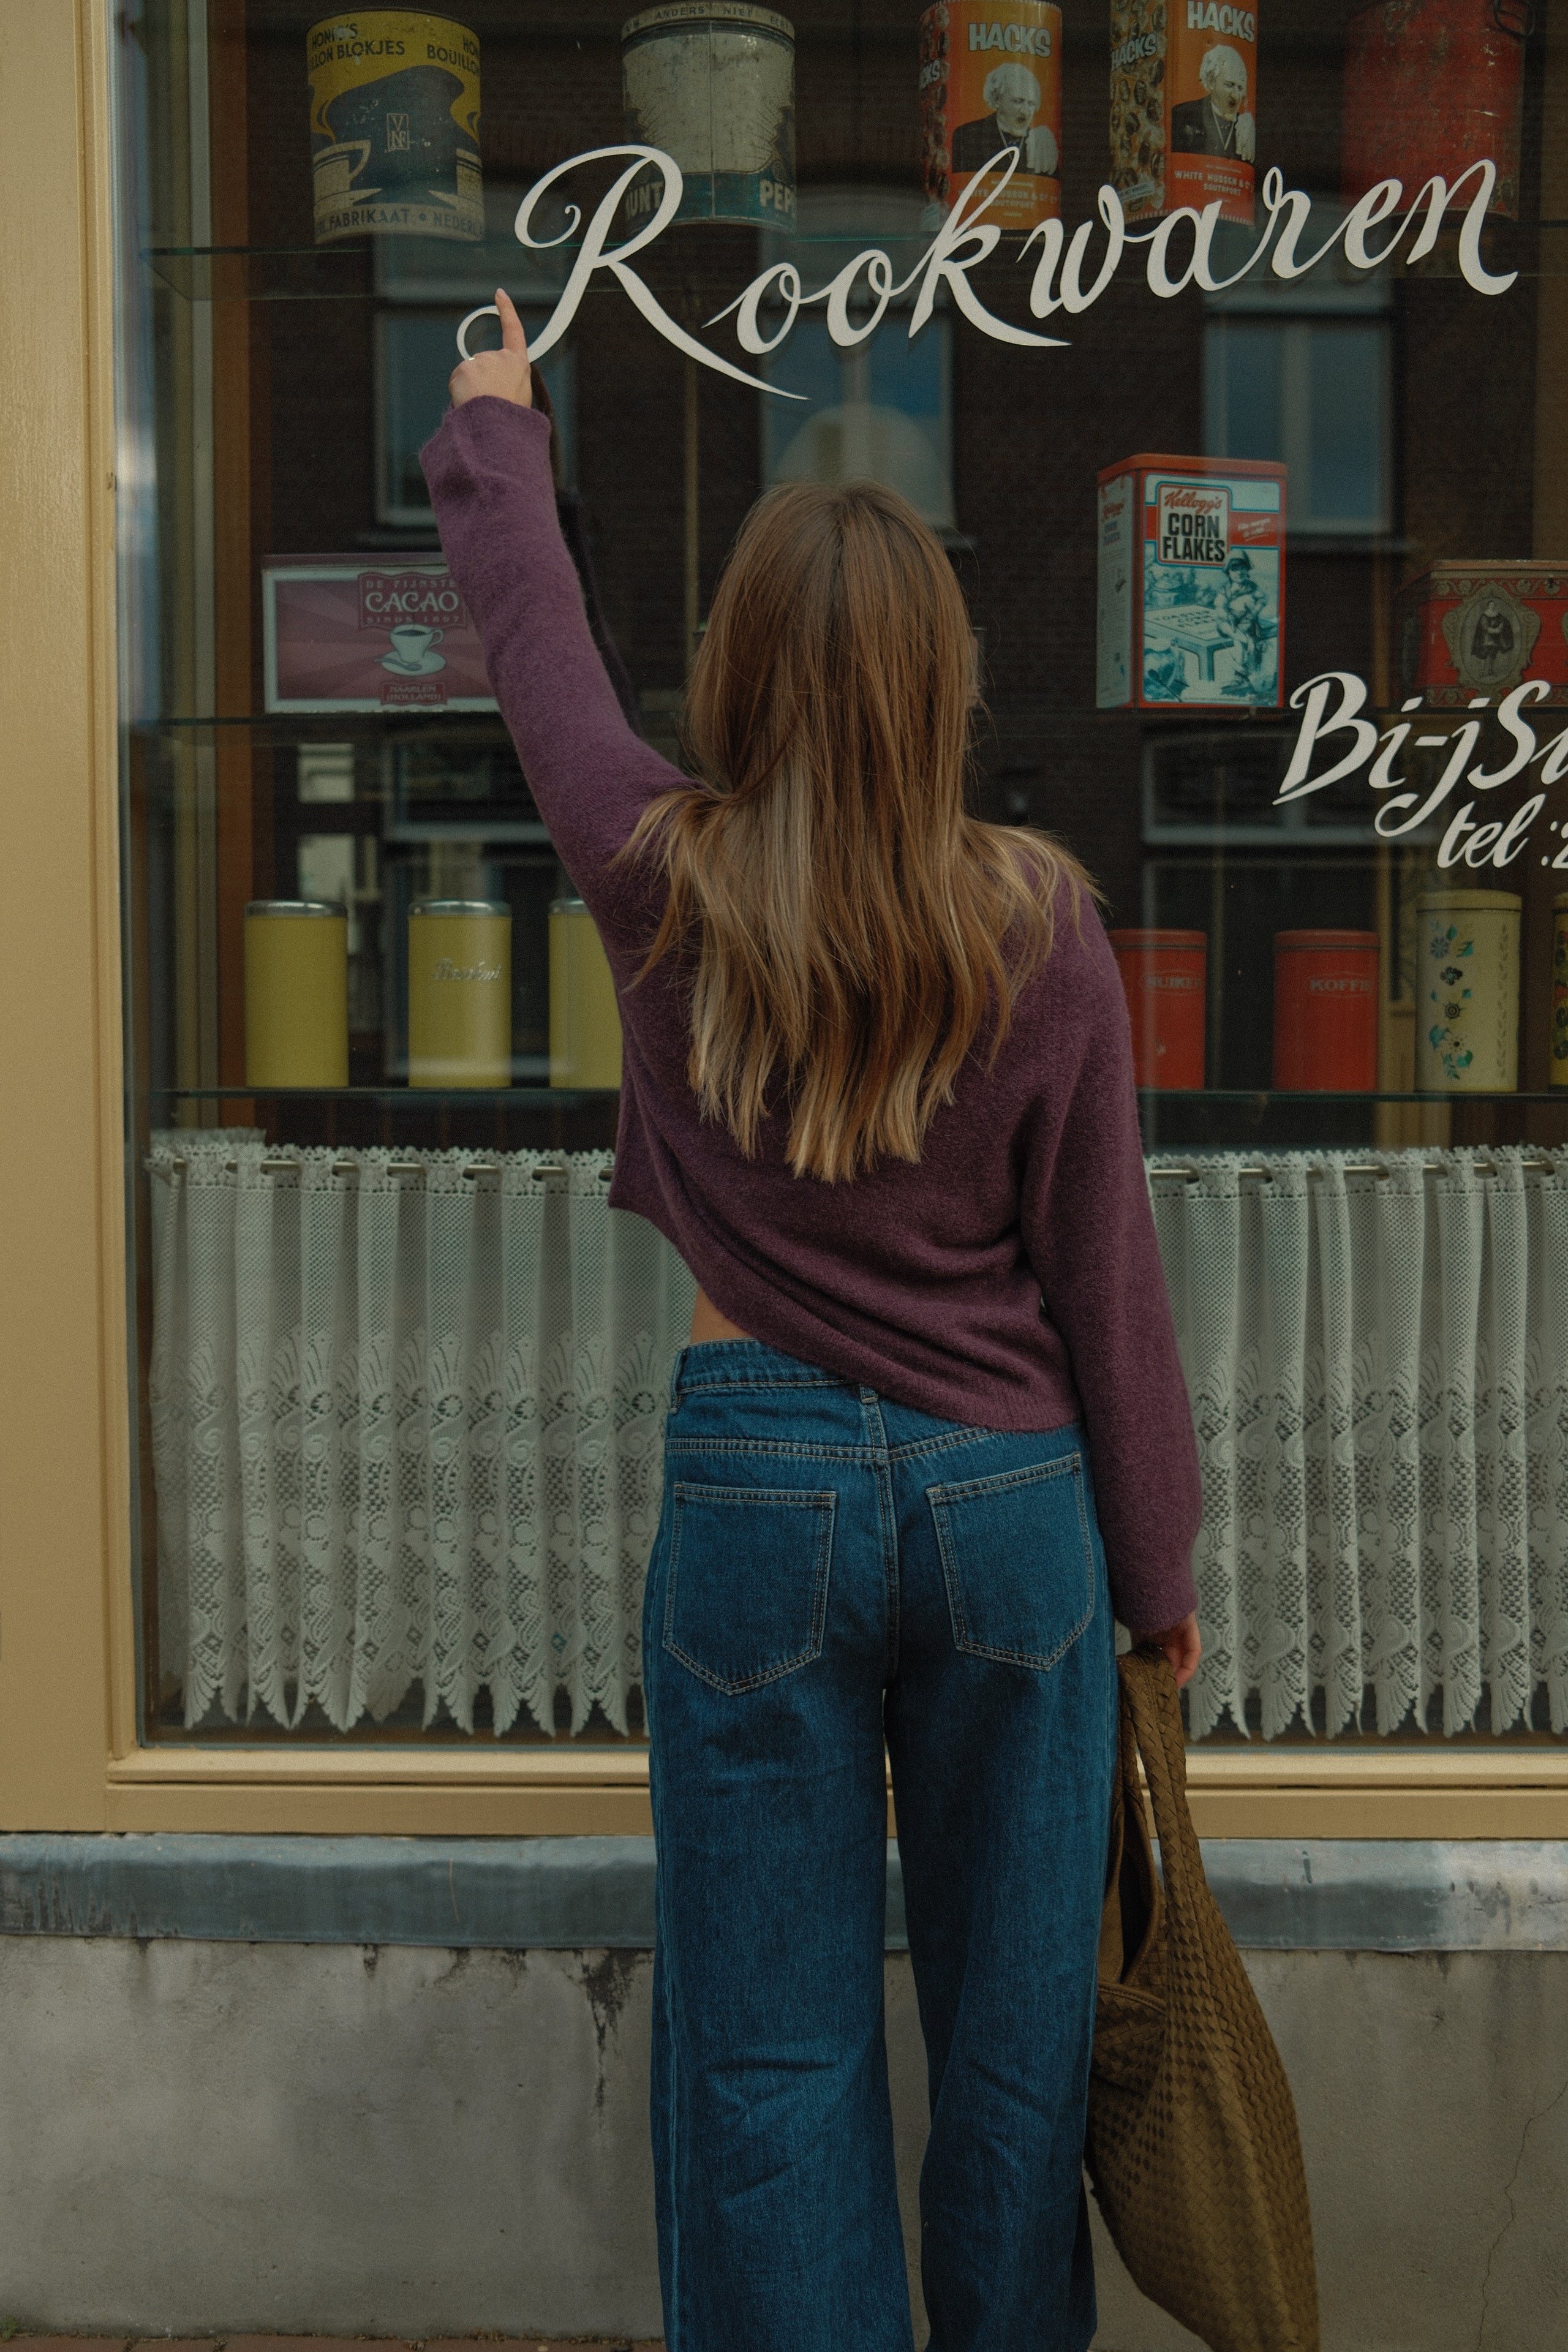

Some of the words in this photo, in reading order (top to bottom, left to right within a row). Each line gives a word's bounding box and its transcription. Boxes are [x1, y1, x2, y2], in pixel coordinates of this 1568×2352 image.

[655, 6, 704, 20] ANDERS
[1187, 1, 1255, 43] HACKS
[337, 40, 405, 59] BLOKJES
[968, 22, 1051, 58] HACKS
[1112, 32, 1158, 70] HACKS
[1174, 170, 1203, 181] WHITE
[329, 209, 409, 230] FABRIKAAT
[456, 145, 1519, 399] Rookwaren
[1164, 489, 1223, 514] Kellogg's
[1168, 513, 1219, 538] CORN
[1163, 536, 1225, 562] FLAKES
[366, 580, 383, 589] DE
[365, 590, 459, 612] CACAO
